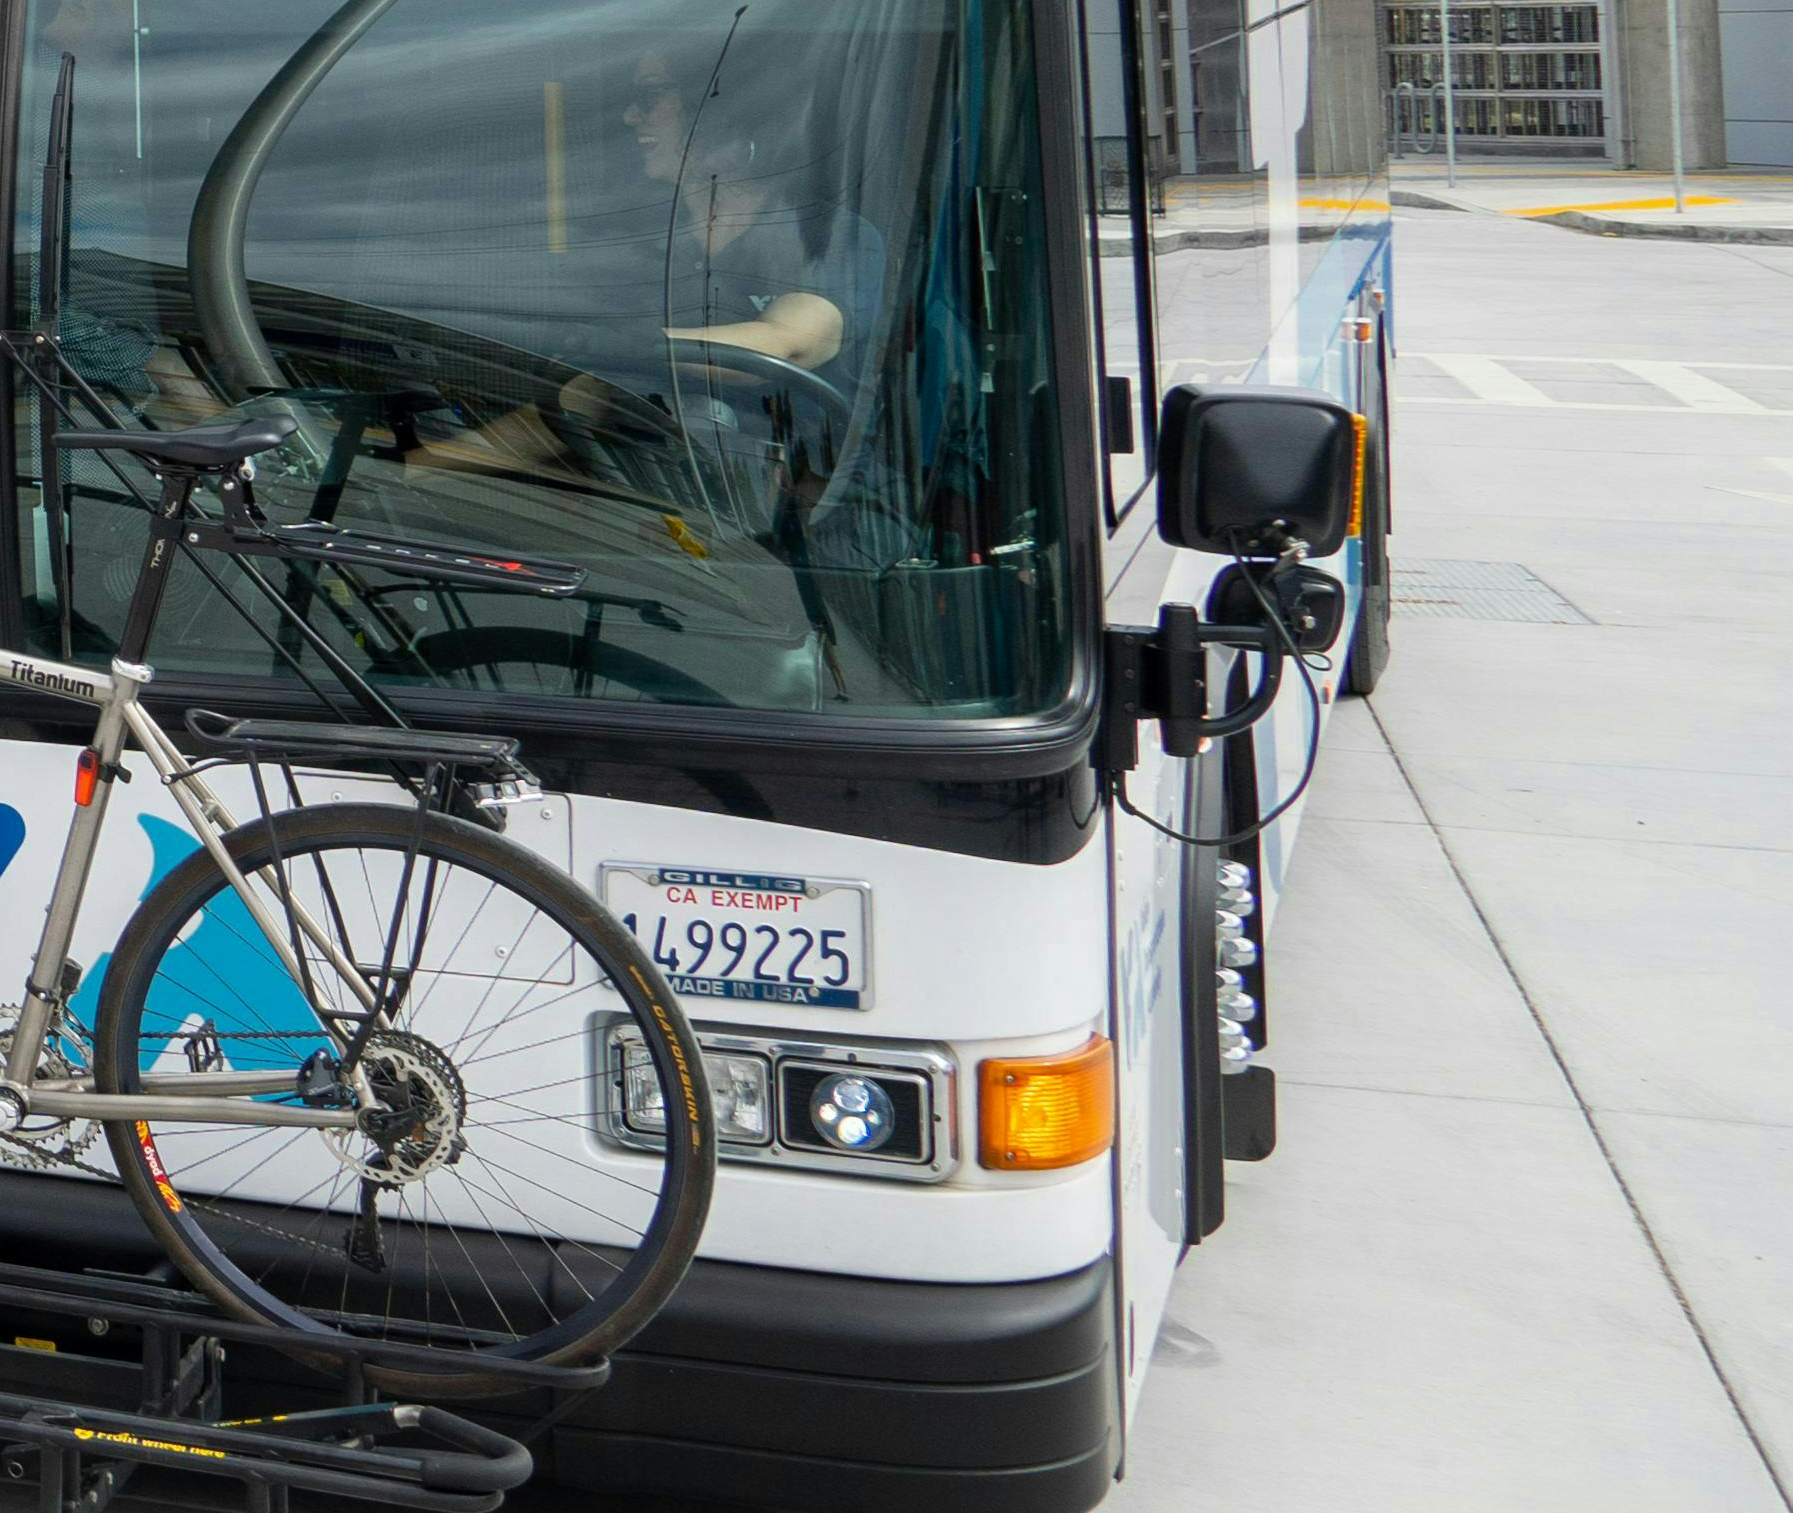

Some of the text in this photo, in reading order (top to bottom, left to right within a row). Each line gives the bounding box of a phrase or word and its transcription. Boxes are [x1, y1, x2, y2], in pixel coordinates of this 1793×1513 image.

[11, 659, 95, 698] Titanium
[663, 871, 803, 890] GILLIG
[666, 887, 803, 913] CA EXEMPT
[666, 977, 725, 997] MADE
[733, 981, 755, 999] IN
[765, 984, 809, 1004] USA
[652, 1004, 699, 1122] GATORSKIN
